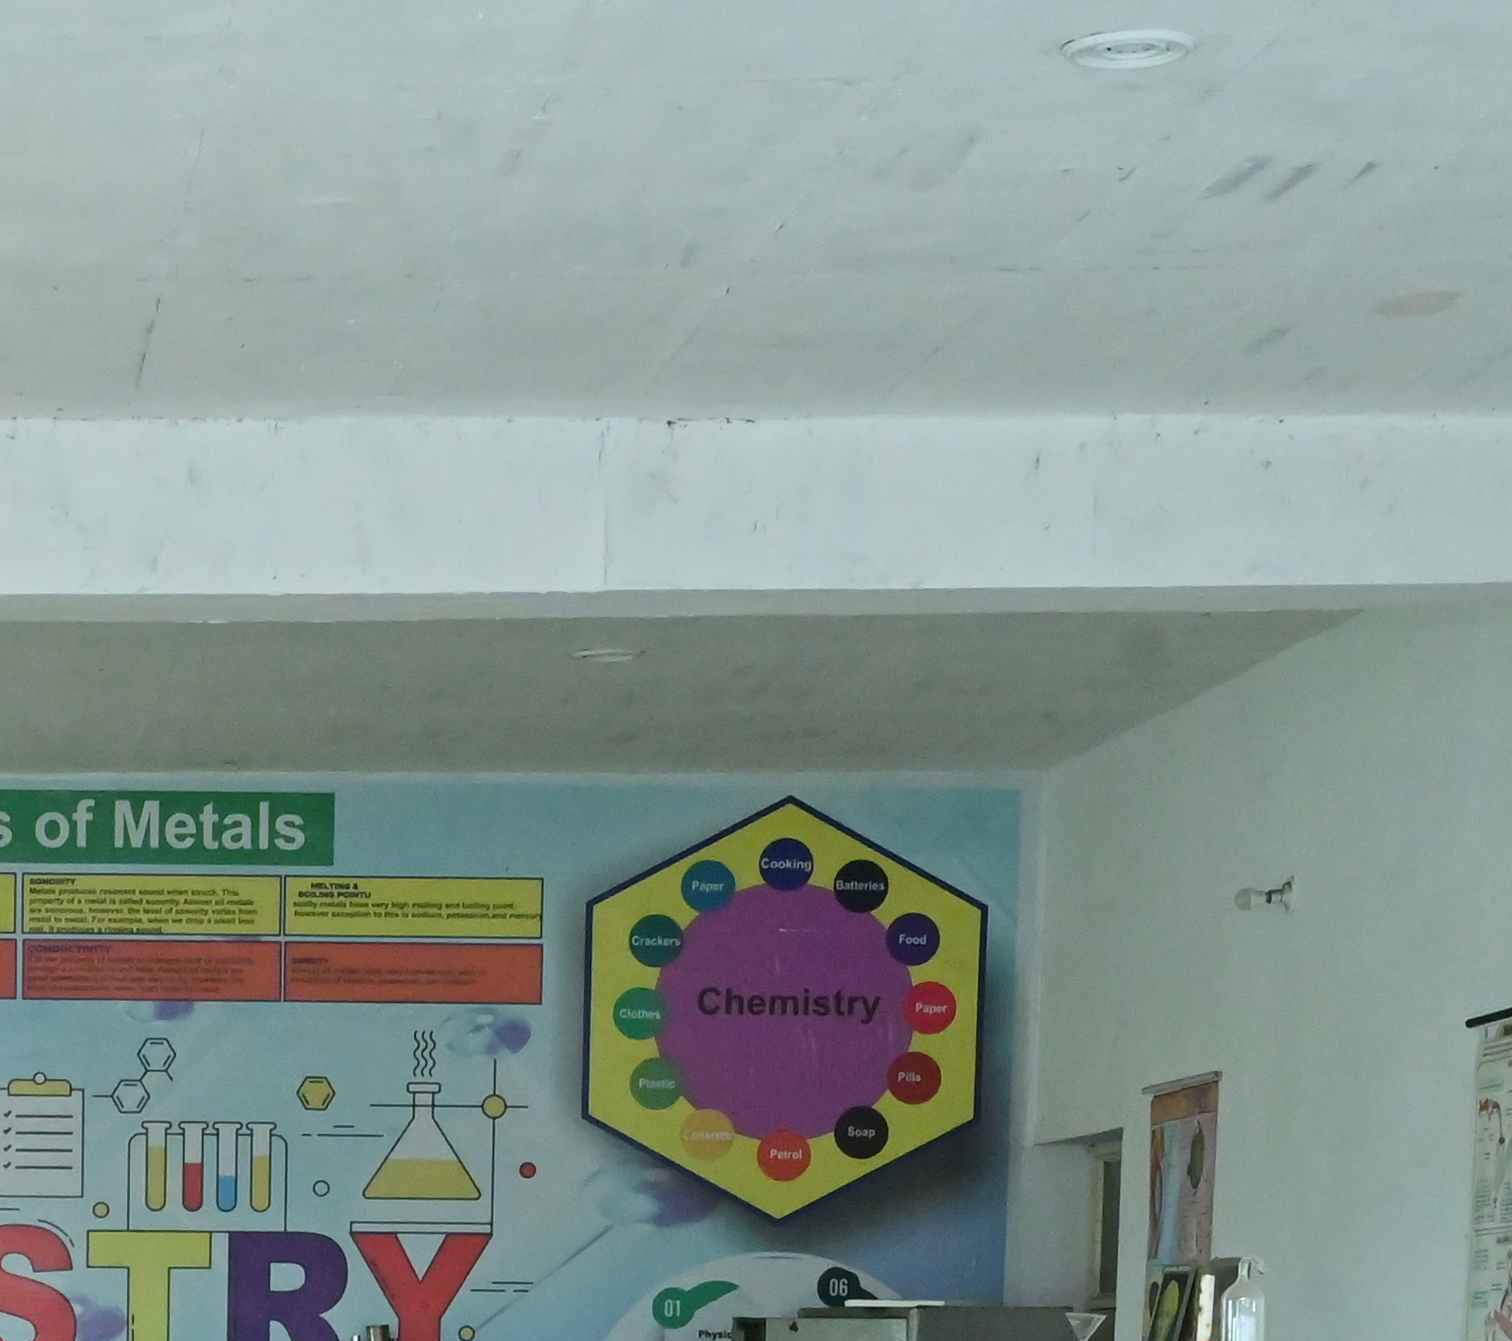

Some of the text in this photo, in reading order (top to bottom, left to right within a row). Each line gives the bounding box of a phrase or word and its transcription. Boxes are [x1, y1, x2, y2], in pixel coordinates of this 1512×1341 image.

[34, 798, 95, 849] of
[114, 799, 305, 850] Metals
[760, 857, 813, 873] Cooking
[691, 881, 725, 894] Paper
[835, 879, 885, 892] Batteries
[631, 935, 680, 946] Crackers
[898, 933, 927, 945] Food
[697, 987, 880, 1025] Chemistry
[915, 1002, 948, 1016] Paper
[619, 1008, 661, 1020] Clothes
[897, 1071, 921, 1083] Pills
[847, 1125, 876, 1140] Soap
[769, 1147, 803, 1160] Petrol
[829, 1278, 848, 1296] 06
[663, 1299, 681, 1317] 01
[697, 1329, 732, 1340] Physic
